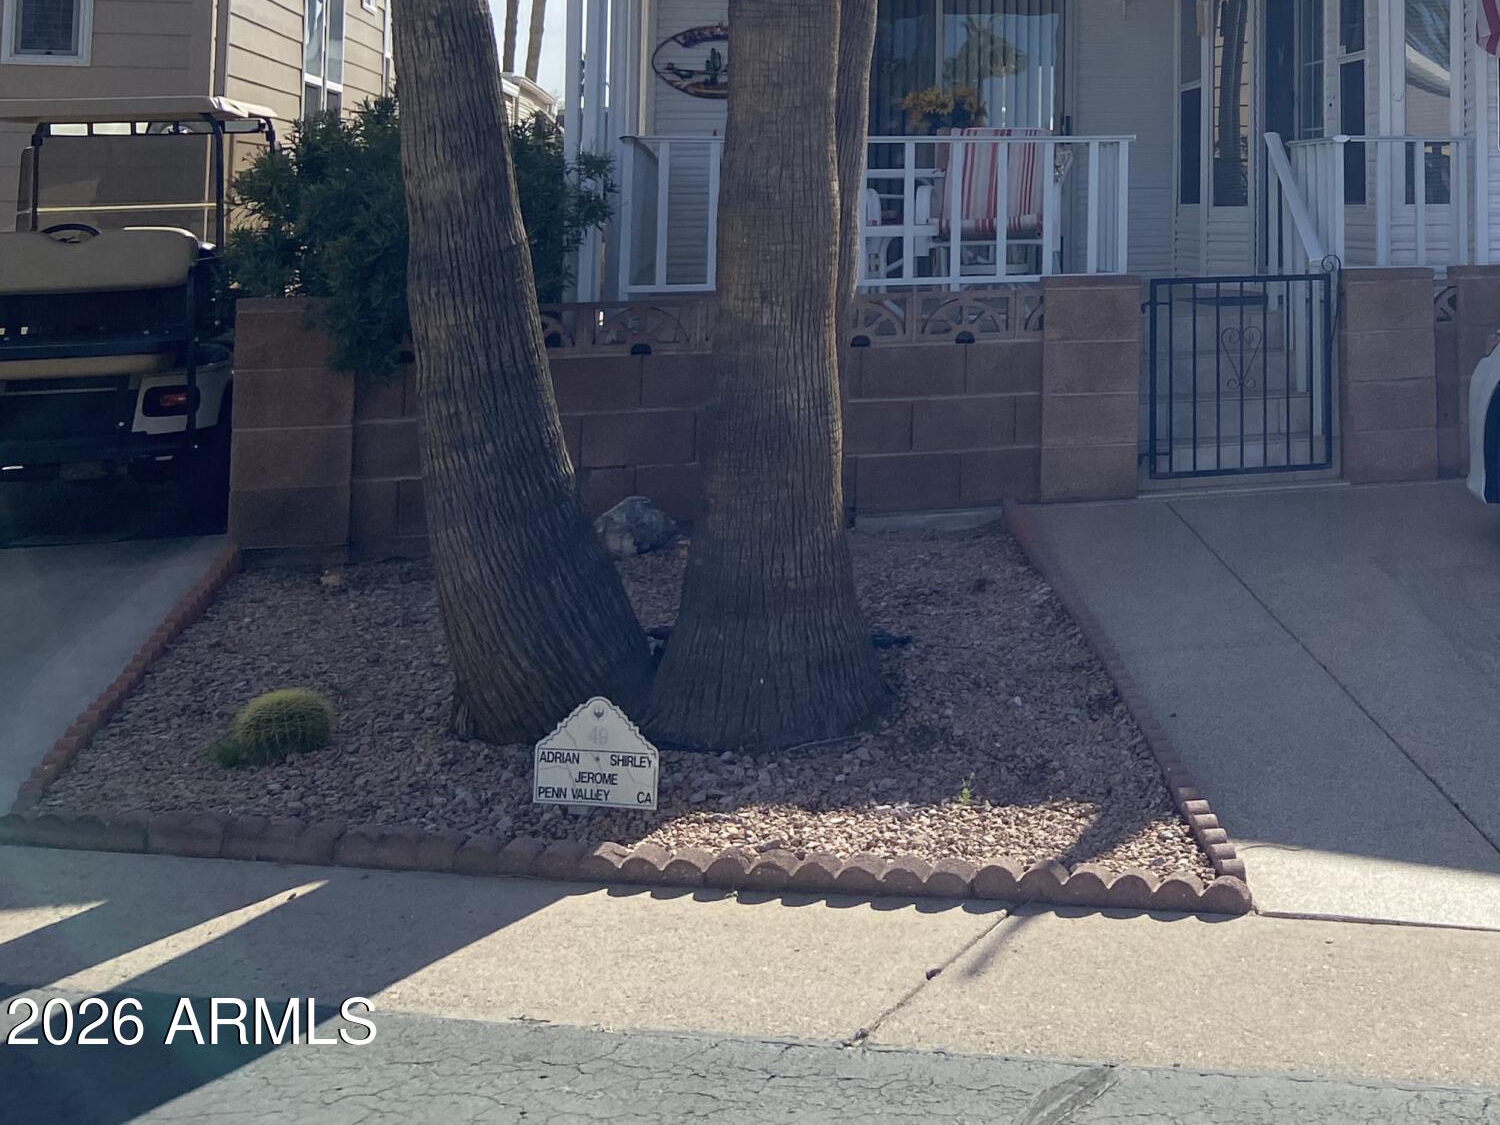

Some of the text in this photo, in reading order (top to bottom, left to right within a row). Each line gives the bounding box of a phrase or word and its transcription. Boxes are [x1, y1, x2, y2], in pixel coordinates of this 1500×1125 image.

[539, 751, 653, 769] ADRIAN SHIRLEY
[574, 771, 618, 785] JEROME
[538, 786, 652, 804] PENN VALLEY CA
